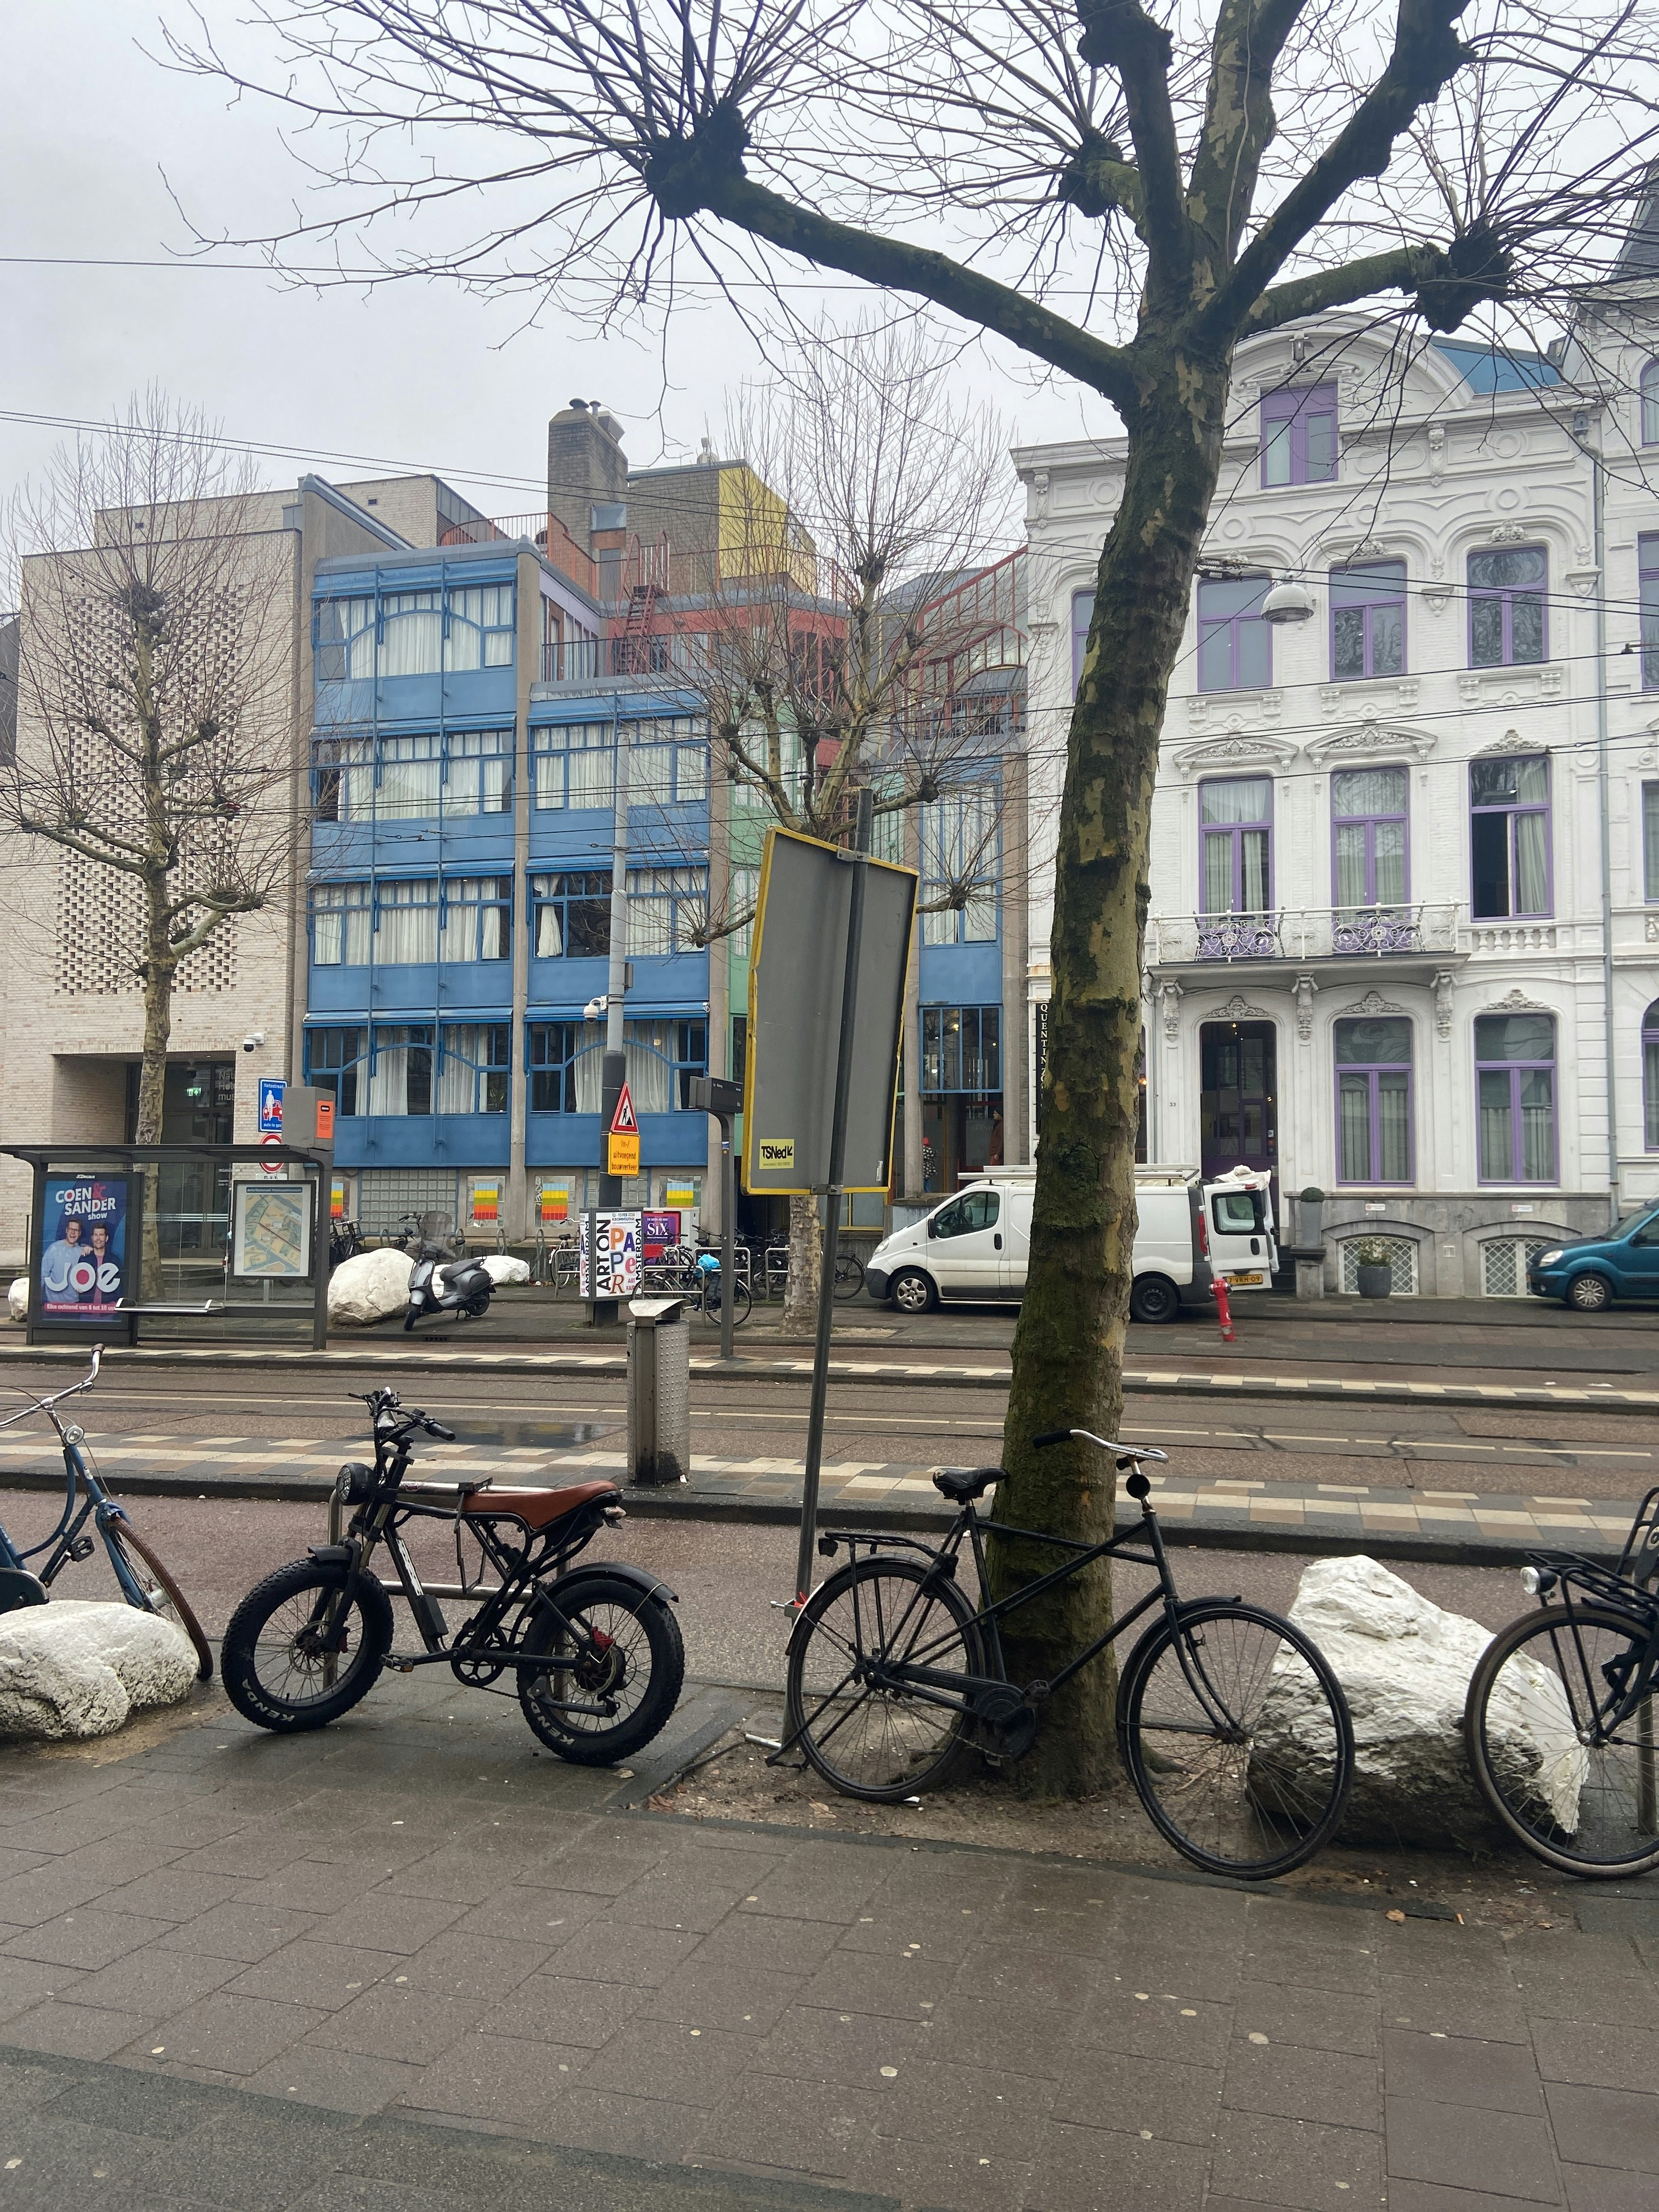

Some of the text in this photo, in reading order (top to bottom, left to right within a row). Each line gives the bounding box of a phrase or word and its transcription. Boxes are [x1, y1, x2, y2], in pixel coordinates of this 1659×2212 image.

[219, 1071, 235, 1080] Nat
[218, 1081, 235, 1091] Hol
[761, 1146, 787, 1159] TSNed
[55, 1187, 92, 1203] COEN
[64, 1197, 116, 1216] SANDER
[87, 1211, 108, 1221] show
[596, 1220, 611, 1251] ON
[596, 1256, 611, 1291] ART
[242, 1679, 295, 1722] KENDA
